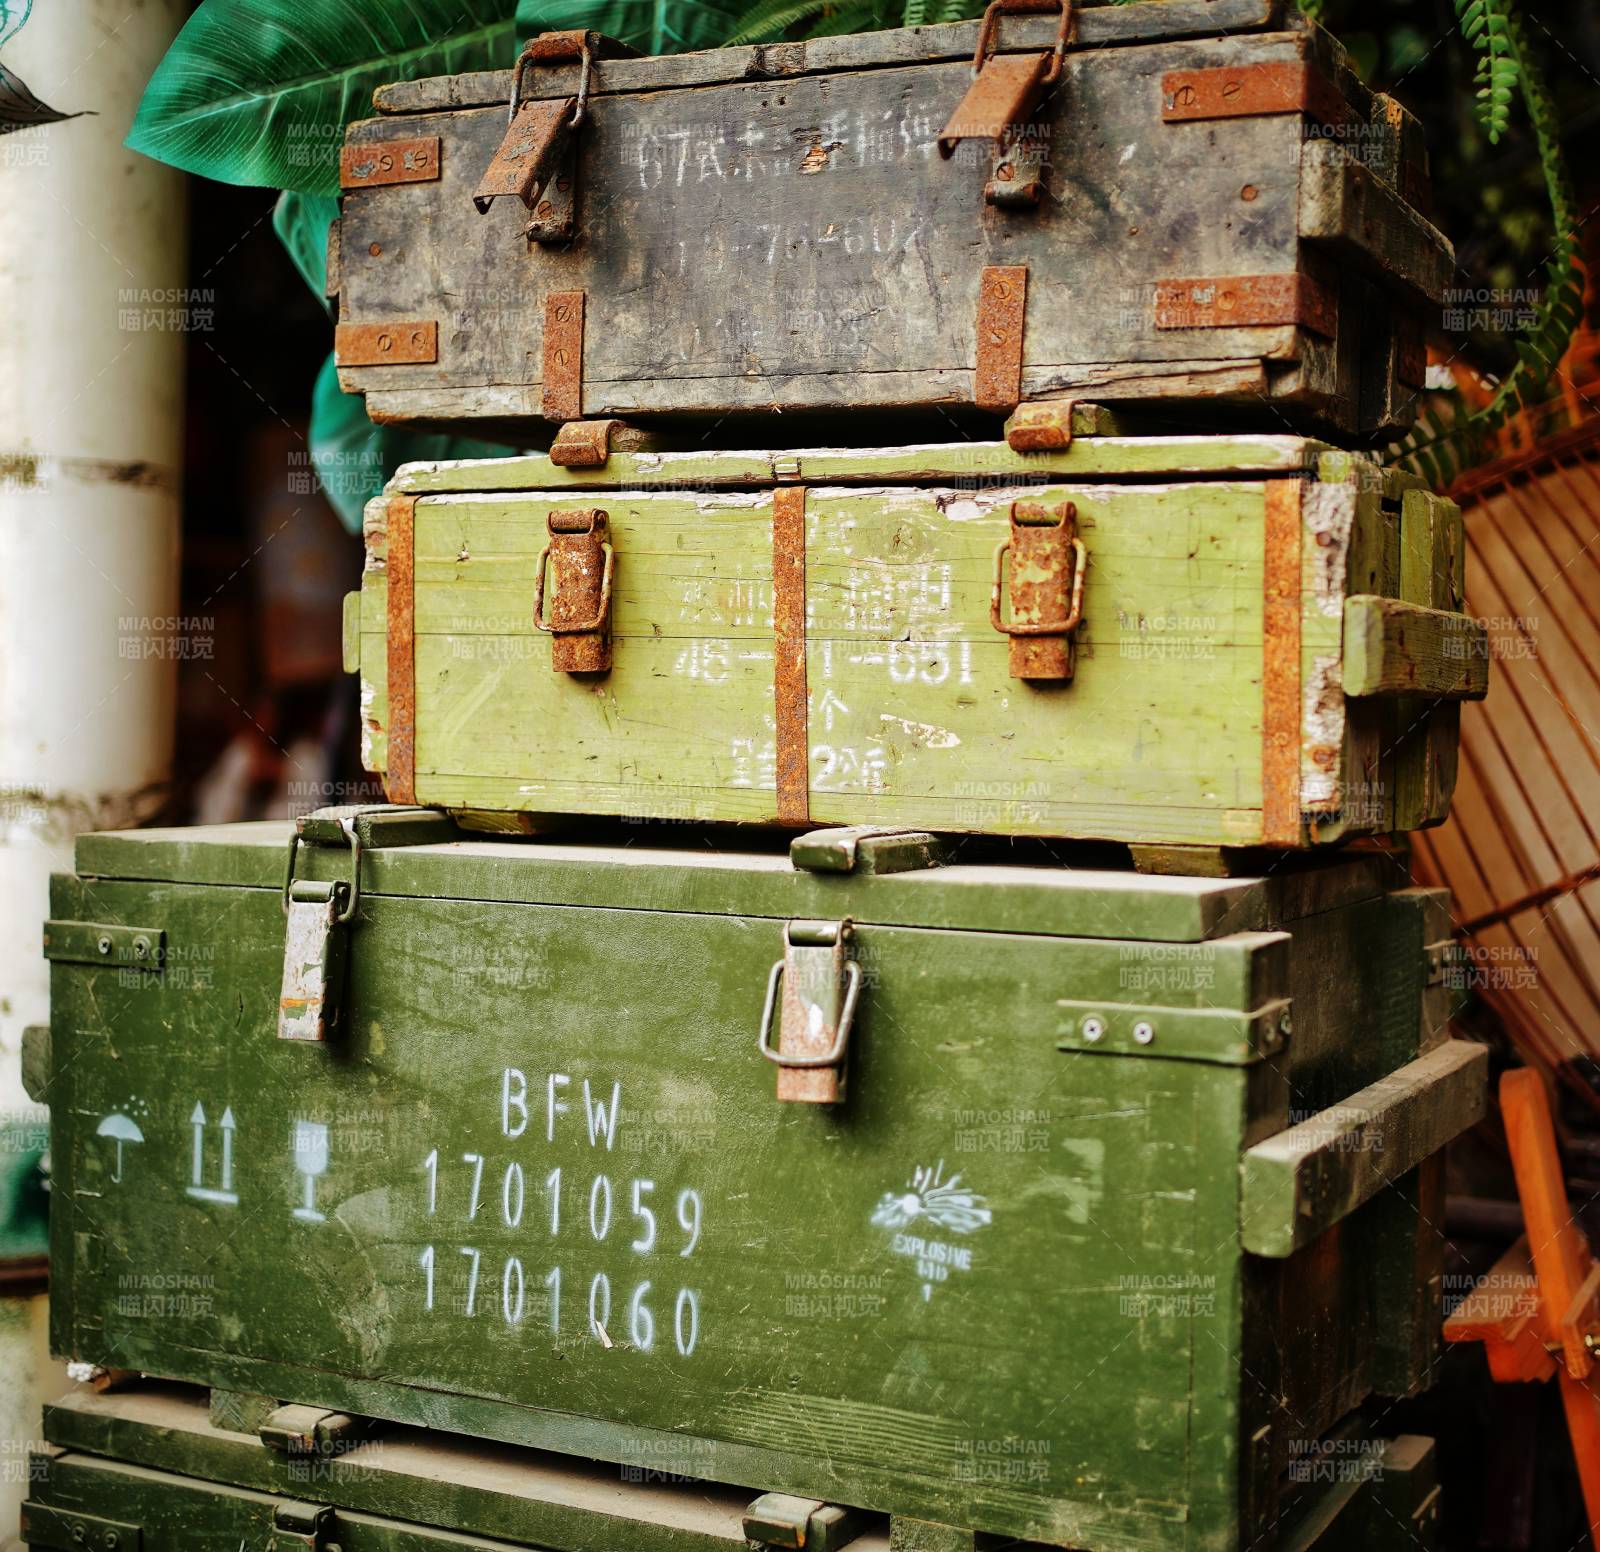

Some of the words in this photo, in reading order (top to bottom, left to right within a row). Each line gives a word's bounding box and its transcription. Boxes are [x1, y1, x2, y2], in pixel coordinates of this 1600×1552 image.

[424, 1148, 702, 1258] 1701059
[894, 1233, 972, 1271] EXPLOSIVE
[421, 1245, 699, 1357] 1701060
